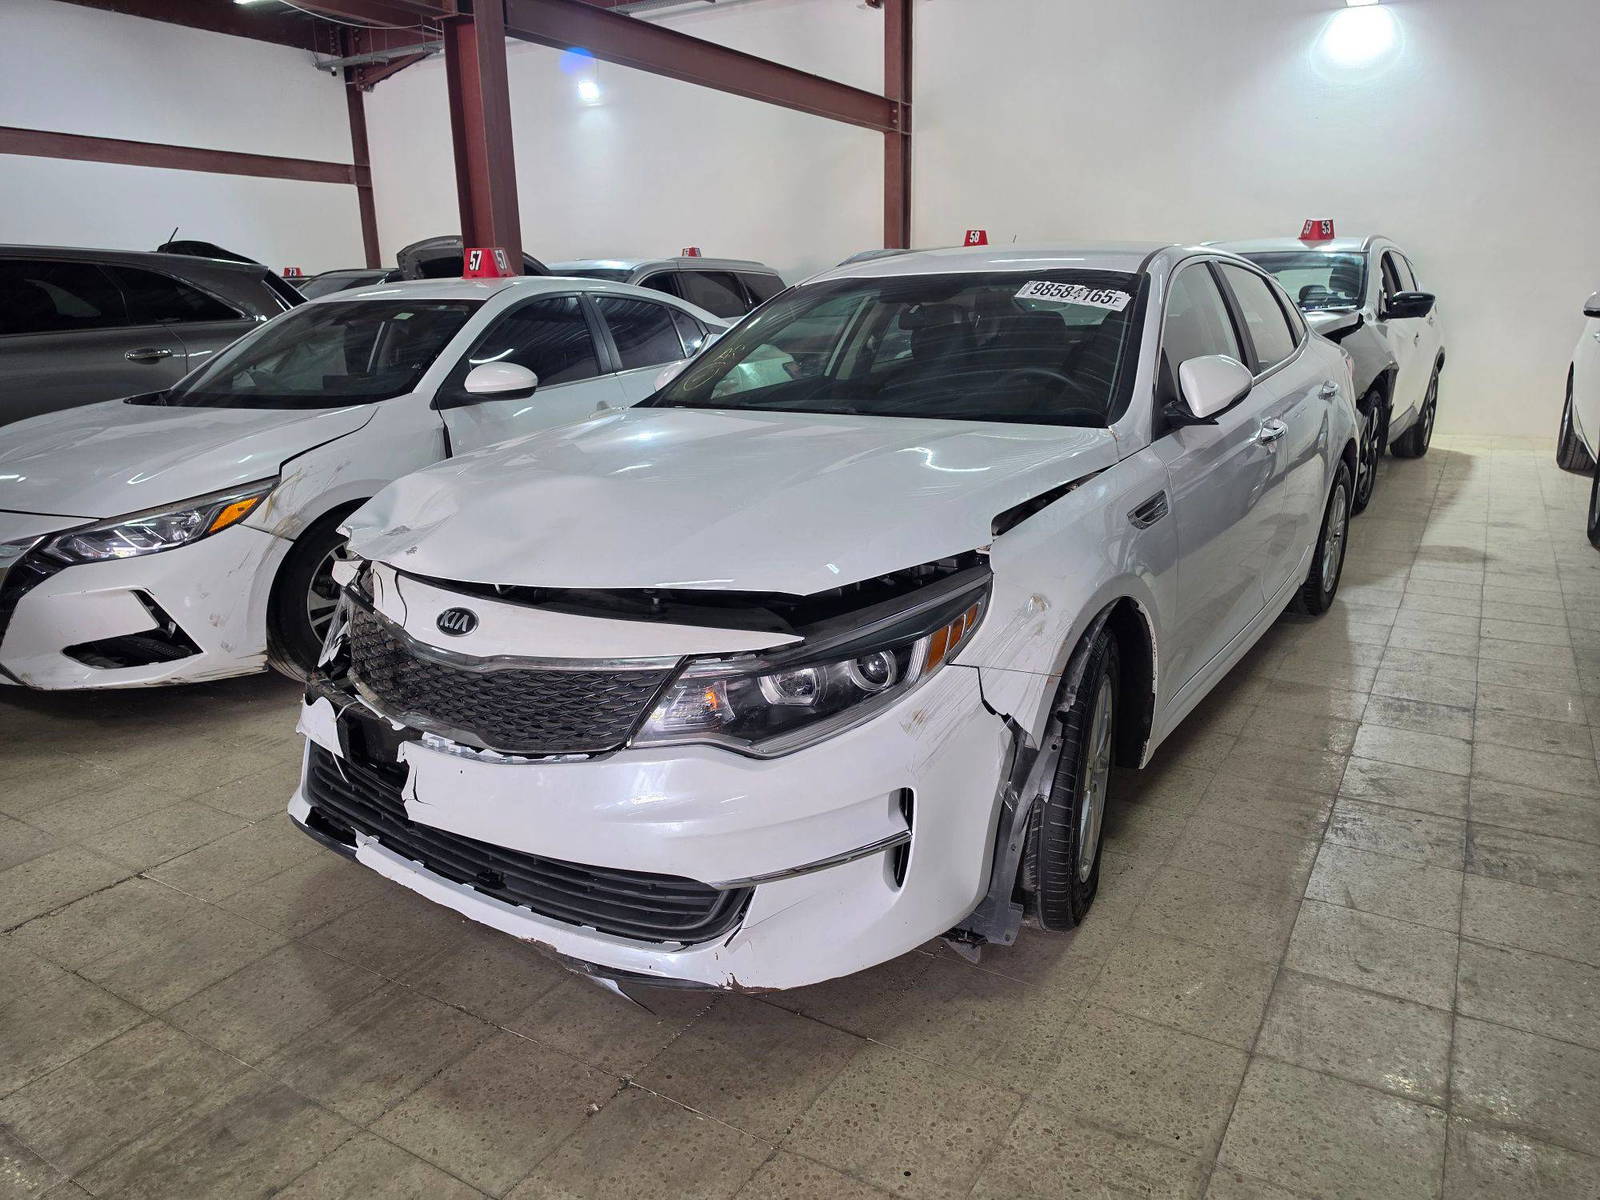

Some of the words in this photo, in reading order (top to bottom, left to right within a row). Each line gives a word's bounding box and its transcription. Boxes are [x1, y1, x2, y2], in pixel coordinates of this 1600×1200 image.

[969, 230, 981, 243] 58
[1321, 220, 1331, 235] 53
[469, 250, 482, 271] 57
[439, 610, 470, 632] KIA
